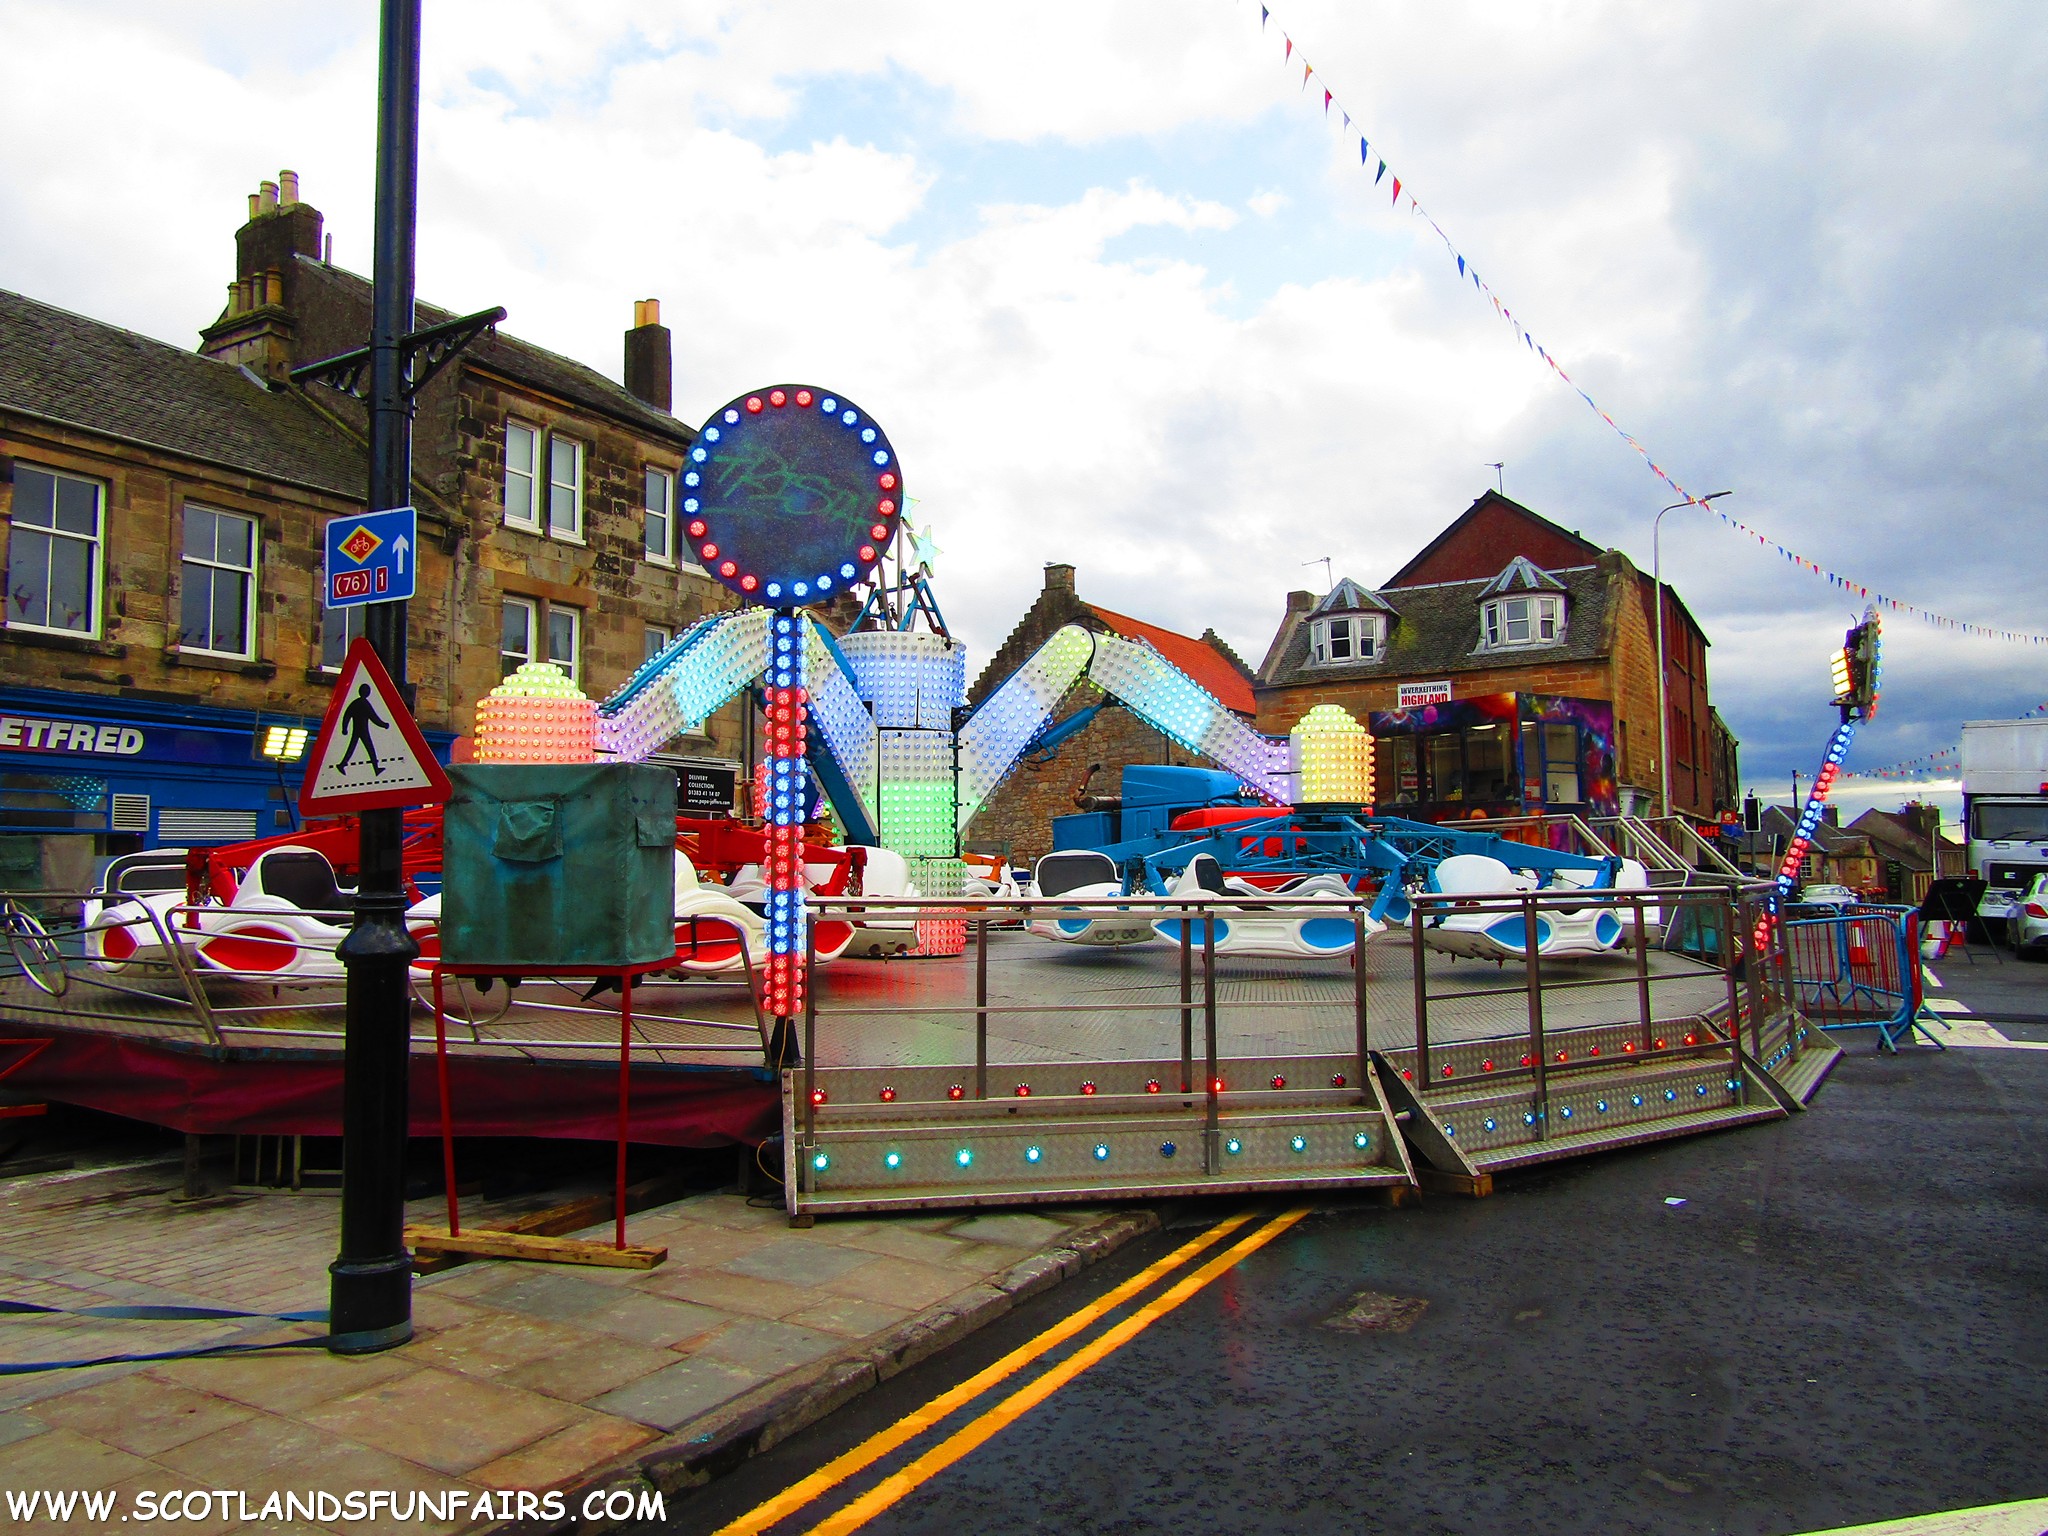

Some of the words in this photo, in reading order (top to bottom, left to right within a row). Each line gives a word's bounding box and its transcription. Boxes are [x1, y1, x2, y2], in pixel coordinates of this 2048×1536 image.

[336, 573, 368, 595] (76)
[379, 572, 384, 587] 1
[1401, 684, 1448, 694] INVERKEITHING
[1401, 693, 1448, 706] HIGHLAND
[1698, 825, 1720, 837] CAFE
